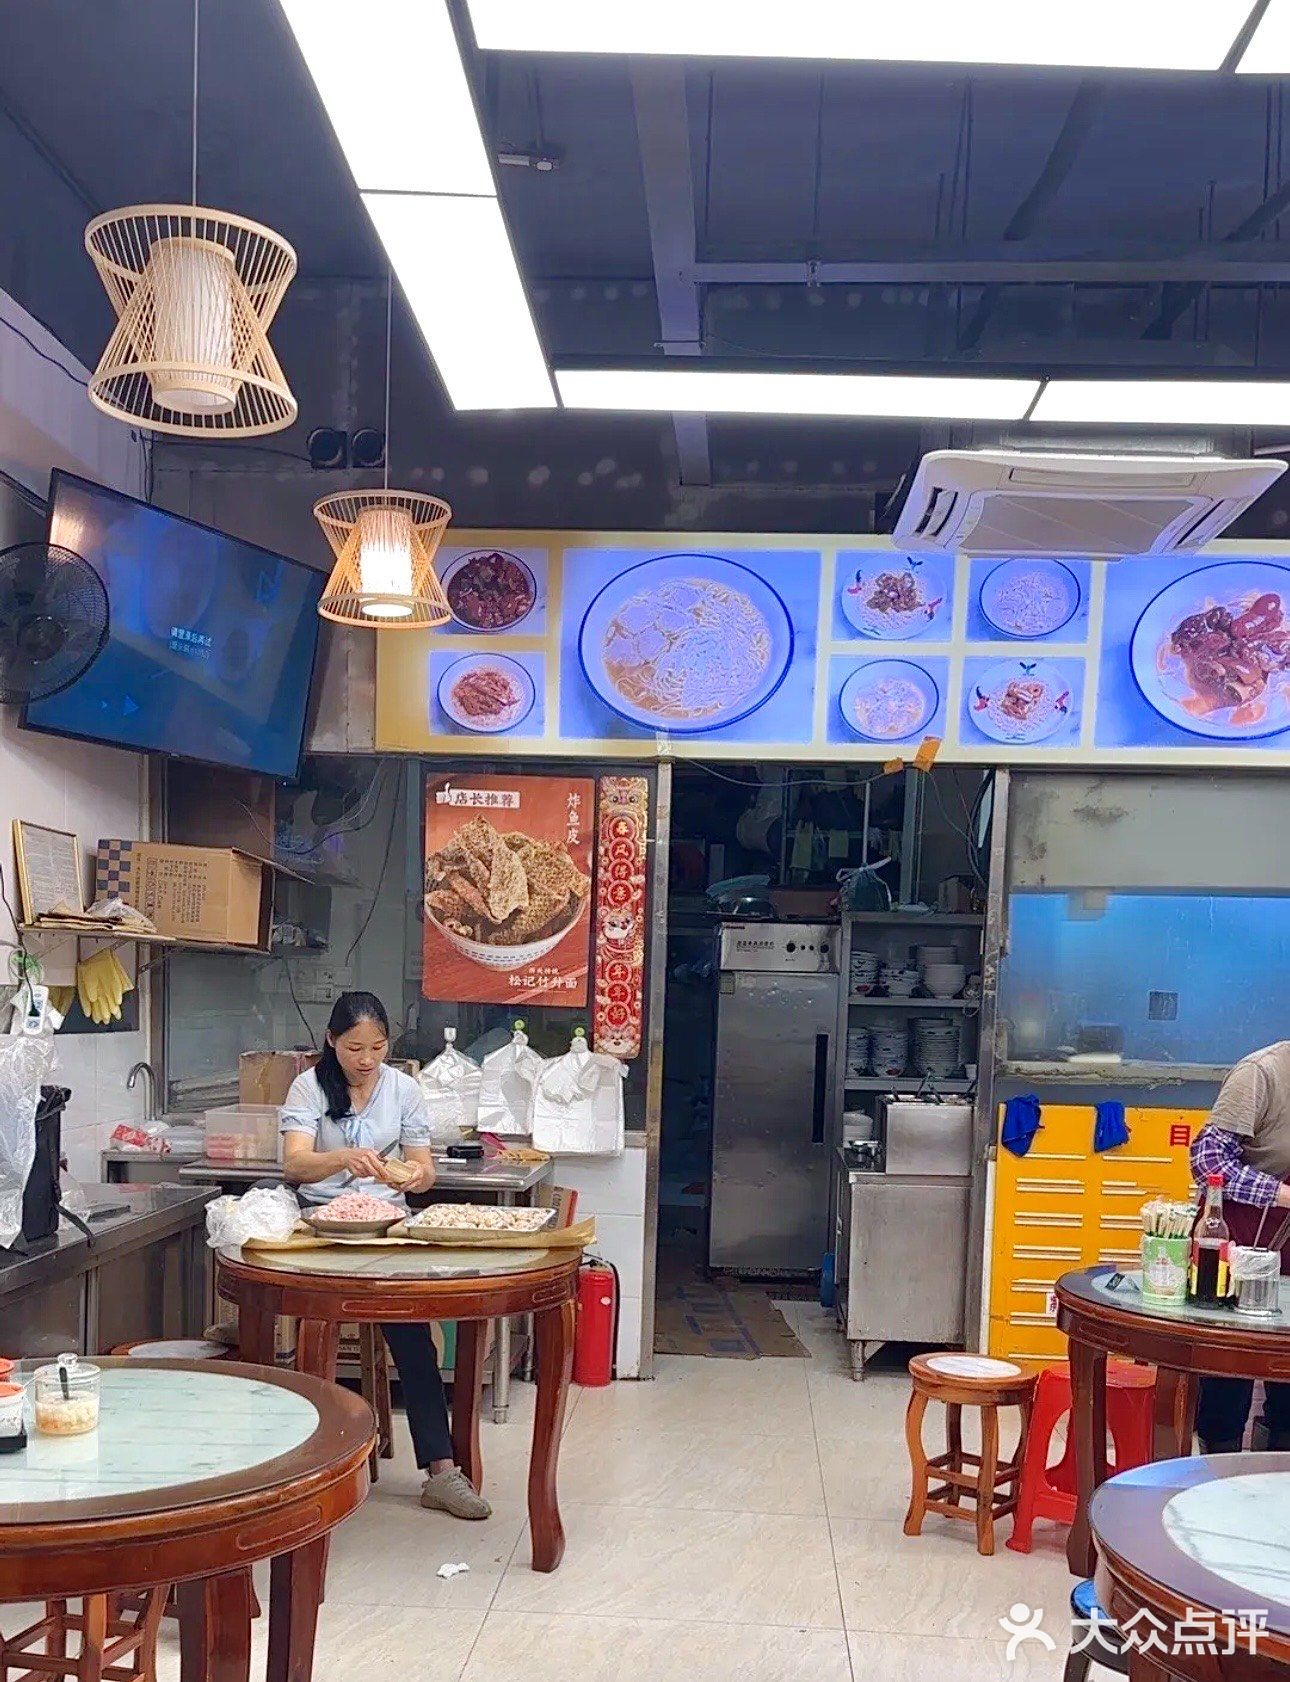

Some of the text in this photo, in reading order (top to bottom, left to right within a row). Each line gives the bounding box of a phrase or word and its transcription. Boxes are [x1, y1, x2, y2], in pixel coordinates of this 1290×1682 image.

[455, 791, 515, 807] 店长推荐
[566, 792, 582, 845] 炸鱼皮
[508, 974, 578, 989] 松记竹升面
